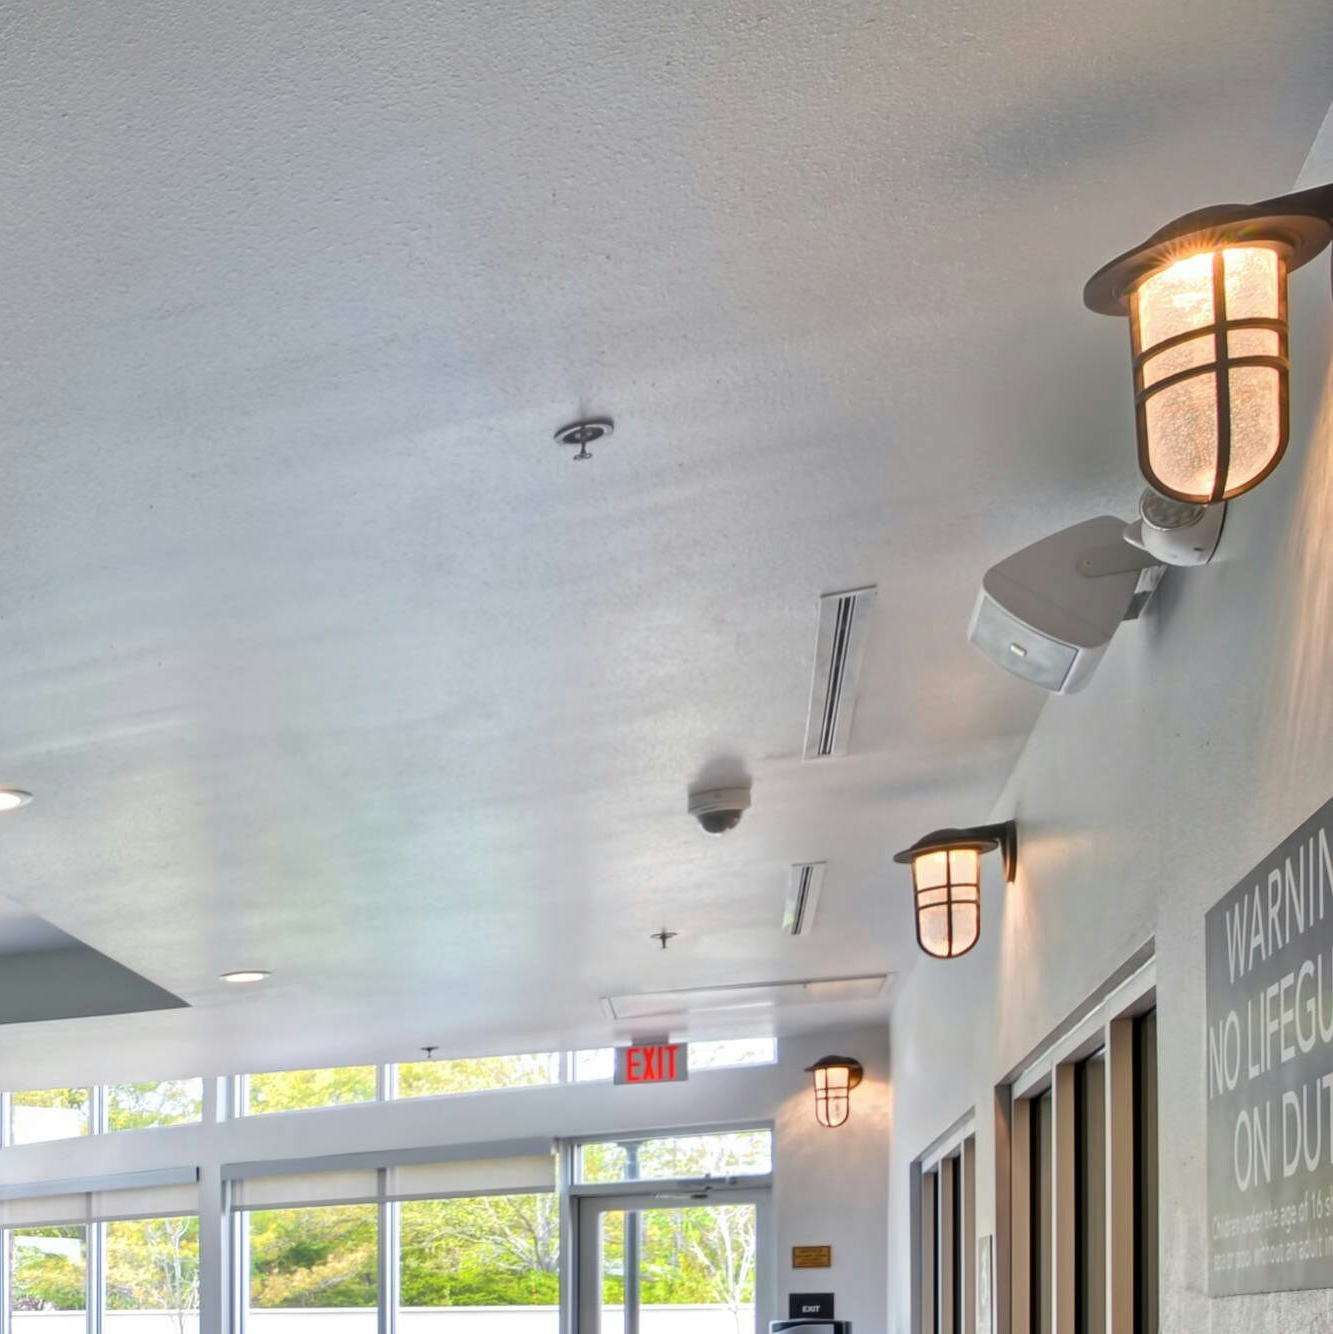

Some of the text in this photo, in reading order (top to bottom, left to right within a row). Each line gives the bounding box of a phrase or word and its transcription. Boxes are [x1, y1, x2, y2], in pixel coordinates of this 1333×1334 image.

[626, 1045, 679, 1082] EXIT
[1209, 1009, 1241, 1100] NO
[1234, 1101, 1271, 1192] ON
[1281, 1205, 1296, 1234] age
[1298, 1191, 1309, 1222] of
[1312, 1190, 1323, 1219] 16
[802, 1305, 821, 1313] EXIT
